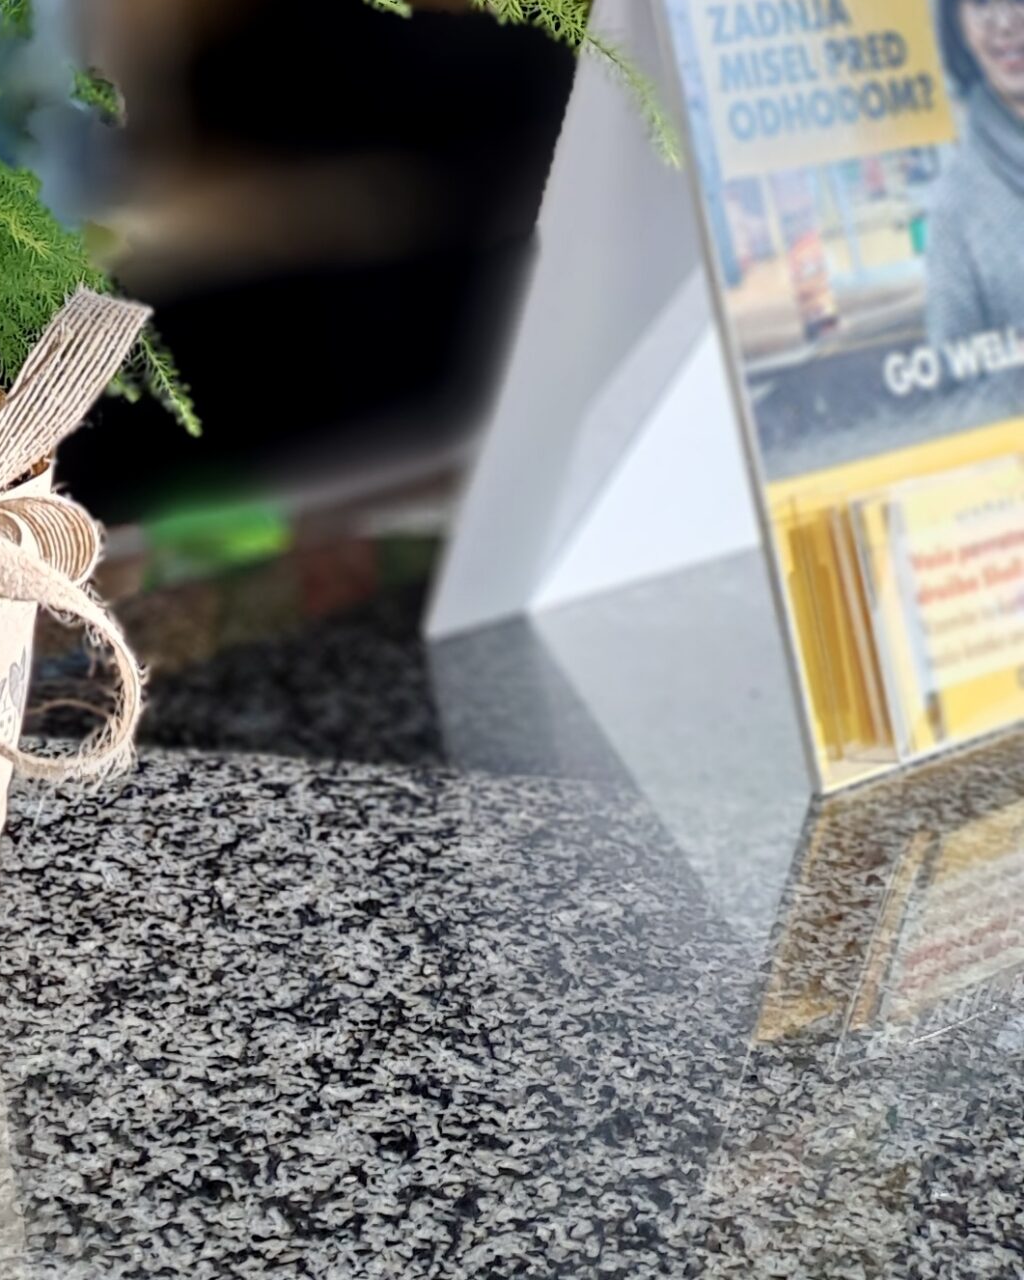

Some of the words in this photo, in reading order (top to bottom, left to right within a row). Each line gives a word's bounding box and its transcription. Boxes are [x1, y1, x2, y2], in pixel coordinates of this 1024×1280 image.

[719, 43, 818, 93] MISEL
[824, 29, 907, 76] PRED
[729, 68, 934, 141] ODHODOM?
[884, 347, 940, 395] GO
